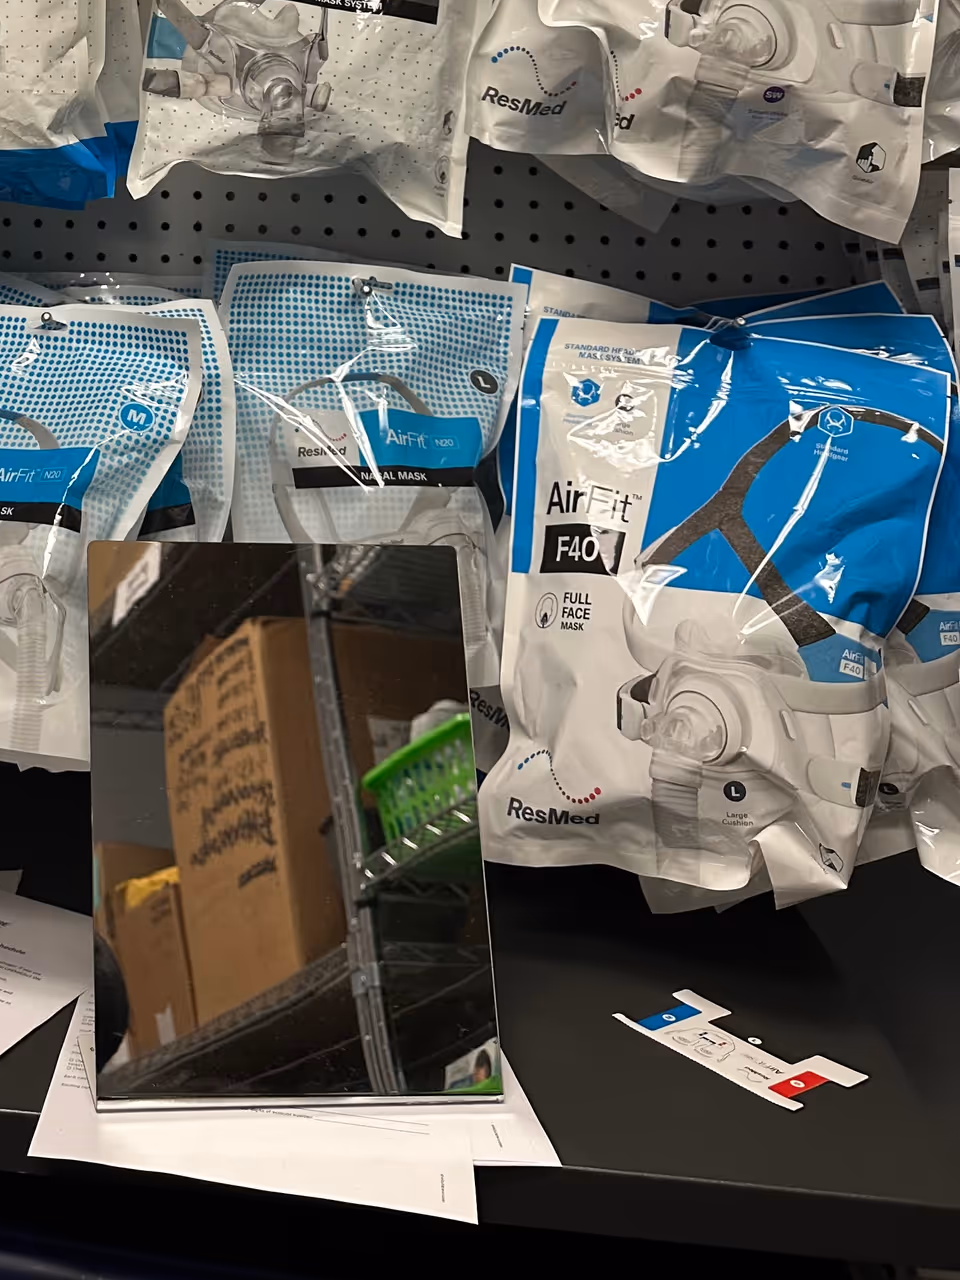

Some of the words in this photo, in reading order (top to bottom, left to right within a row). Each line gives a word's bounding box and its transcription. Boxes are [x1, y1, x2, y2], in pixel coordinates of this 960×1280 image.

[765, 90, 783, 99] SW
[481, 86, 567, 117] ResMed
[564, 343, 610, 353] STANDARD
[479, 375, 490, 388] L
[129, 410, 146, 424] M
[386, 428, 426, 450] AirFit
[297, 445, 347, 459] ResMed
[815, 442, 850, 455] Standard
[44, 470, 62, 480] N20
[398, 471, 428, 482] MASK
[556, 534, 599, 562] F40
[563, 592, 592, 606] FULL
[561, 606, 591, 620] FACE
[560, 622, 585, 632] MASK
[943, 634, 958, 644] F40
[843, 662, 862, 676] F40
[731, 786, 740, 797] L
[507, 797, 600, 826] ResMed
[725, 811, 749, 821] Large
[722, 818, 754, 827] Cushion
